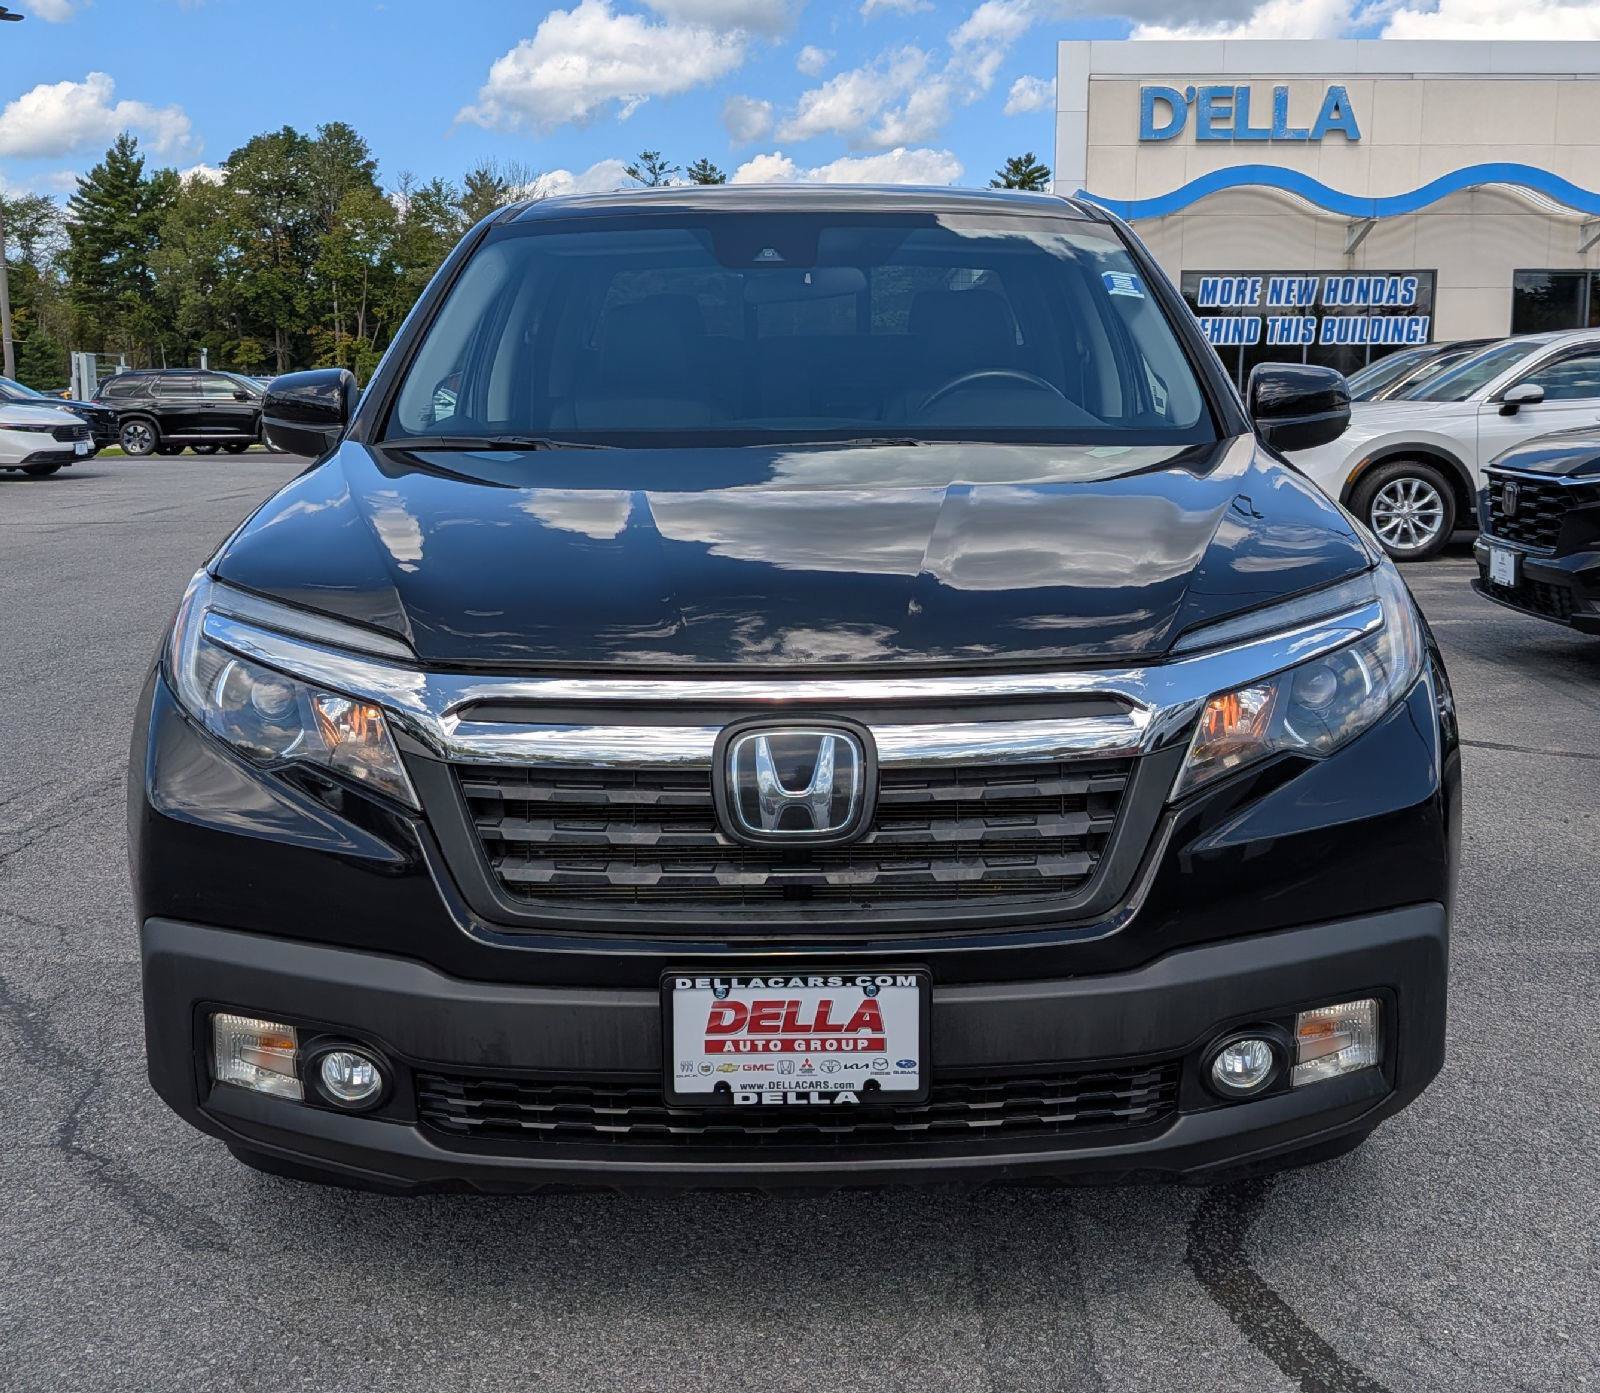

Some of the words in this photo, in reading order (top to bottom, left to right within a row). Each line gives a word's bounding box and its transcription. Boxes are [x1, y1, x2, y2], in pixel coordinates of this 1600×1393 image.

[1198, 277, 1262, 307] MORE
[1266, 277, 1319, 306] NEW
[1322, 276, 1418, 306] HONDAS
[1266, 316, 1317, 345] THIS
[1319, 316, 1429, 345] BUILDING!
[675, 975, 918, 989] DELLACARS.COM
[705, 999, 885, 1034] DELLA
[722, 1039, 782, 1052] AUTO
[794, 1039, 869, 1052] GROUP
[742, 1063, 775, 1072] GMC
[740, 1080, 855, 1091] www.DELLACARS.com
[733, 1091, 860, 1105] DELLA
